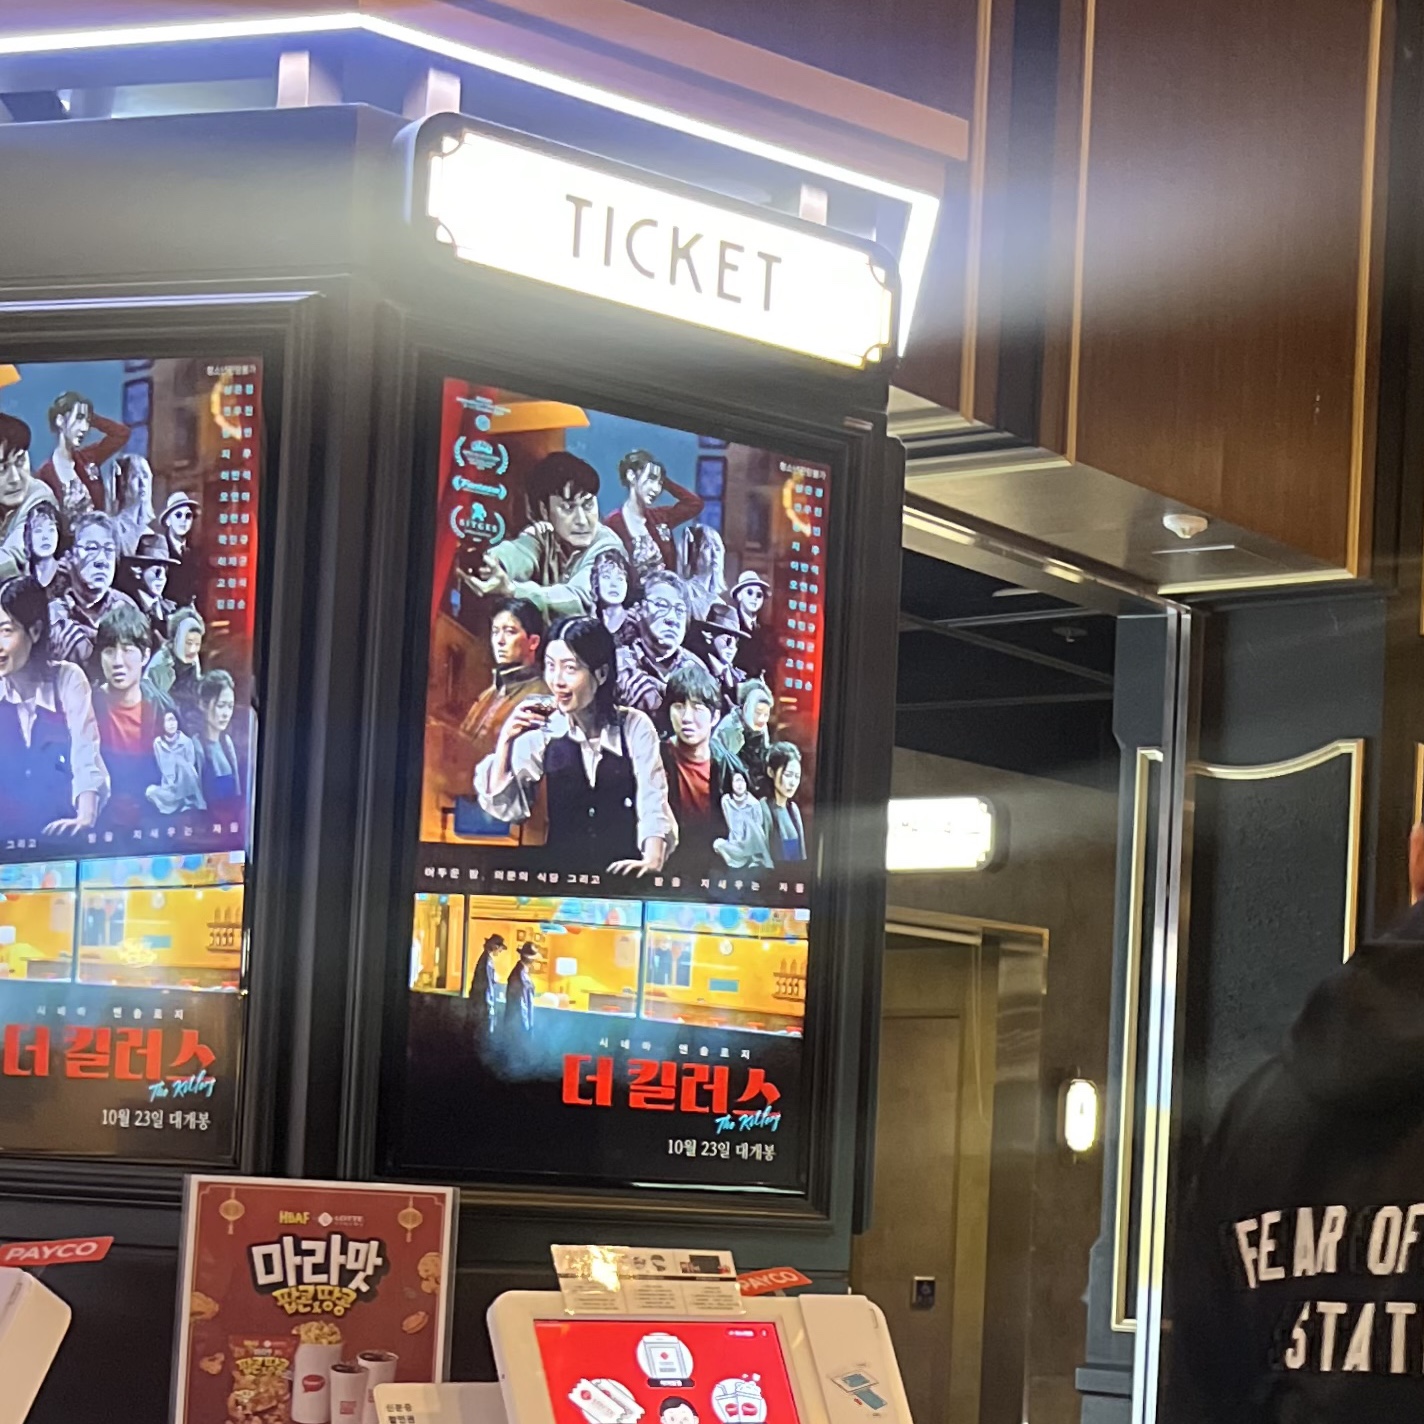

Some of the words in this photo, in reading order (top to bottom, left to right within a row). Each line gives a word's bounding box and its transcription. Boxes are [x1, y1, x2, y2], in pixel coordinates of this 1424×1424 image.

[565, 194, 782, 311] TICKET
[567, 873, 600, 885] 그리고
[3, 1024, 50, 1077] 더
[64, 1025, 216, 1081] 킬러스
[562, 1053, 614, 1106] 더
[627, 1058, 781, 1117] 킬러스
[102, 1108, 130, 1127] 10월
[134, 1110, 164, 1129] 23일
[169, 1111, 211, 1130] 대개봉
[668, 1139, 697, 1157] 10월
[701, 1141, 730, 1159] 23일
[735, 1142, 776, 1161] 대개봉
[279, 1211, 310, 1224] HBAF
[5, 1242, 98, 1261] PAYCO
[1234, 1204, 1348, 1289] FEAR
[251, 1234, 383, 1292] 마라맛
[738, 1271, 798, 1291] PAYCO
